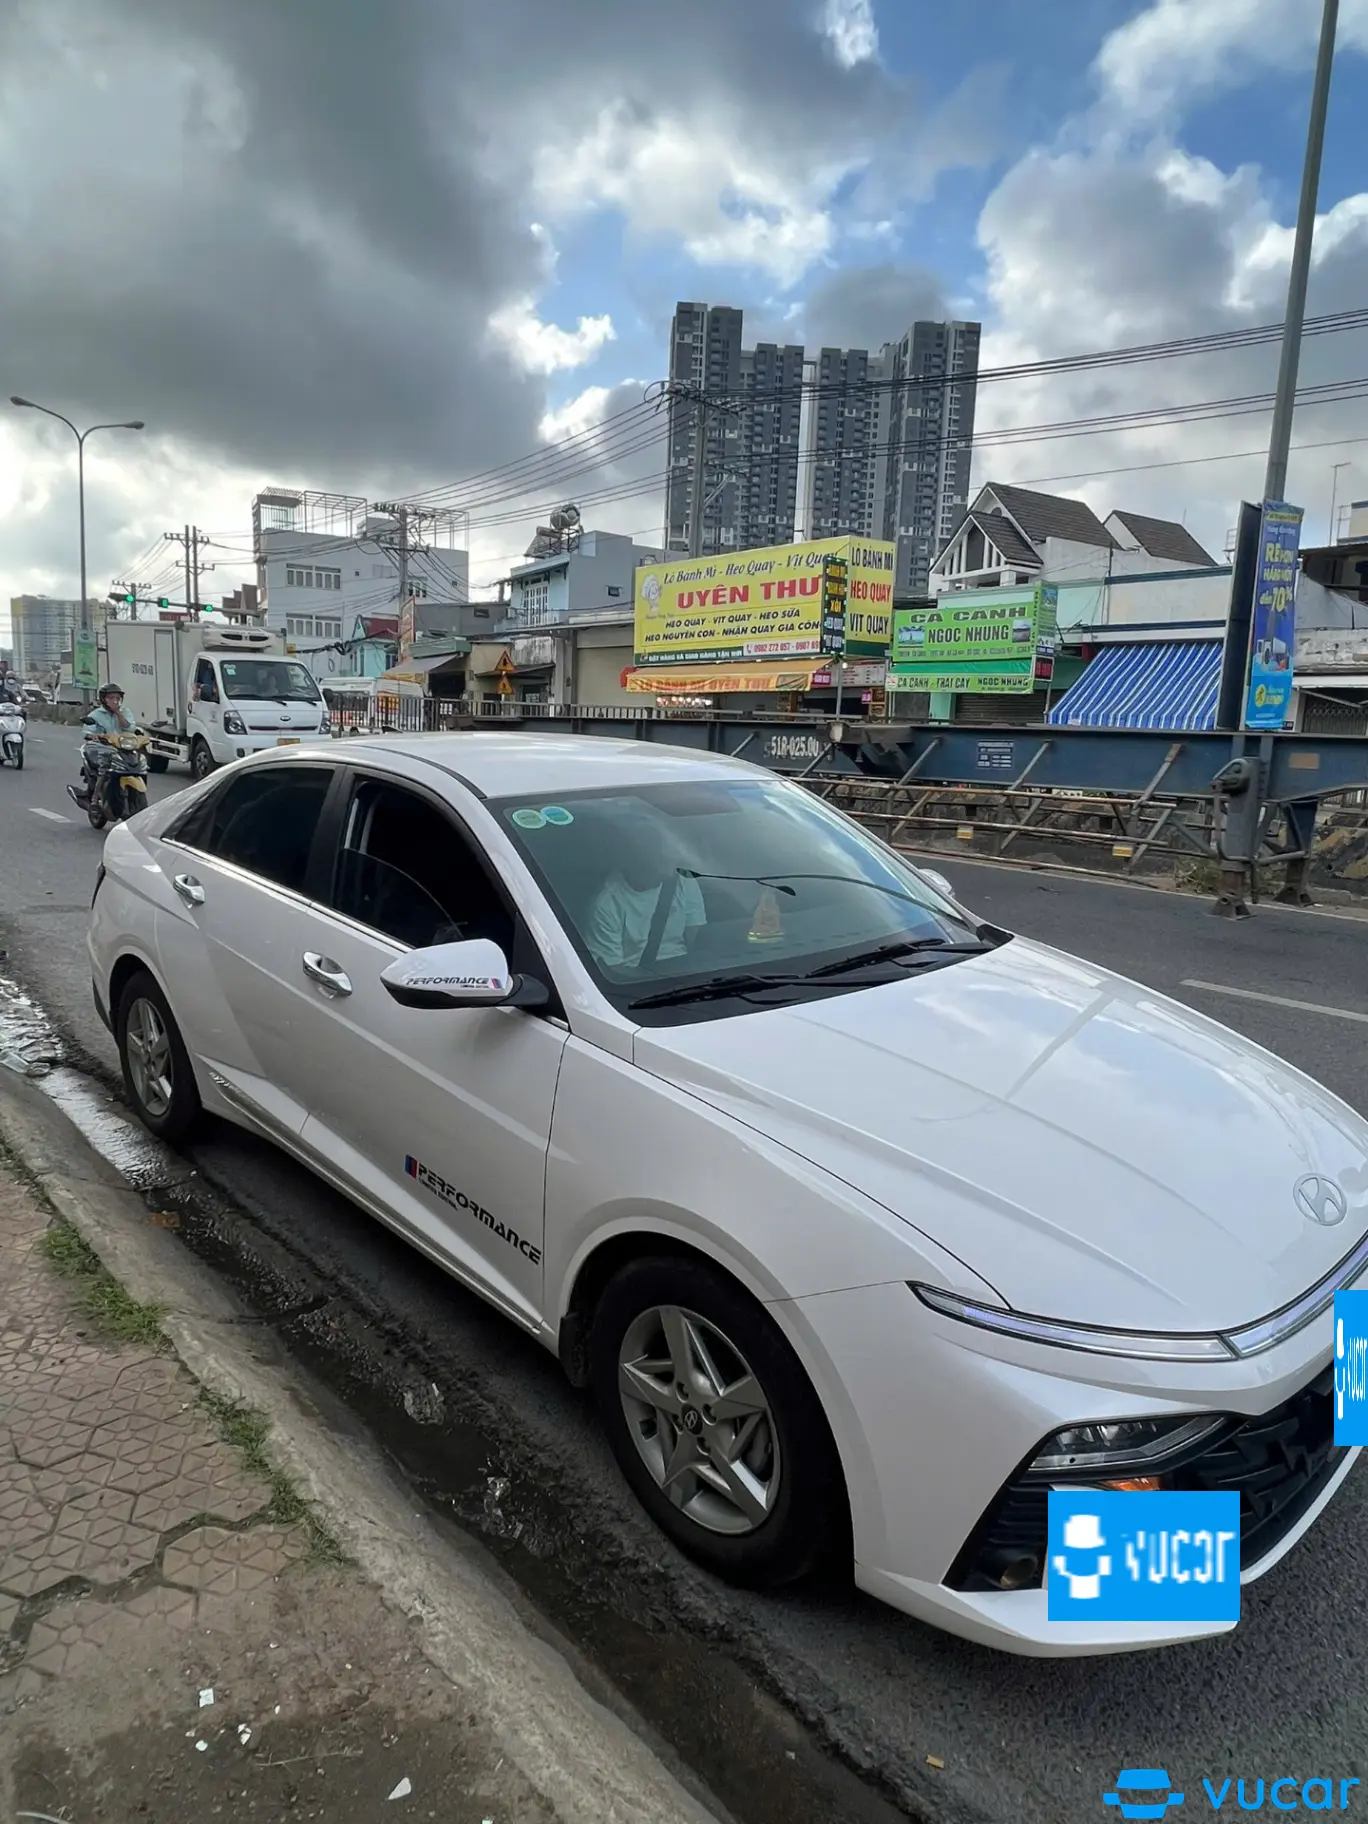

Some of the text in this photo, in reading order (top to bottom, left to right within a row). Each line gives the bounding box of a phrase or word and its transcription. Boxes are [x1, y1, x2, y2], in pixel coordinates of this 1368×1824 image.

[725, 562, 745, 576] Heo
[747, 559, 776, 575] Quay
[677, 584, 749, 609] UYÊN
[760, 573, 824, 600] THƯ
[851, 580, 868, 600] HEO
[870, 582, 891, 603] QUAY
[665, 619, 682, 629] HEO
[684, 617, 707, 628] QUAY
[727, 613, 752, 625] QUAY
[759, 610, 779, 621] HEO
[850, 613, 864, 636] VỊT
[867, 615, 888, 635] QUAY
[645, 633, 662, 643] HEO
[750, 623, 775, 635] QUAY
[777, 621, 795, 632] GIA
[965, 625, 1009, 642] NHUNG
[406, 976, 489, 986] PERFORMANCE
[418, 1162, 542, 1265] PERFORMANCE
